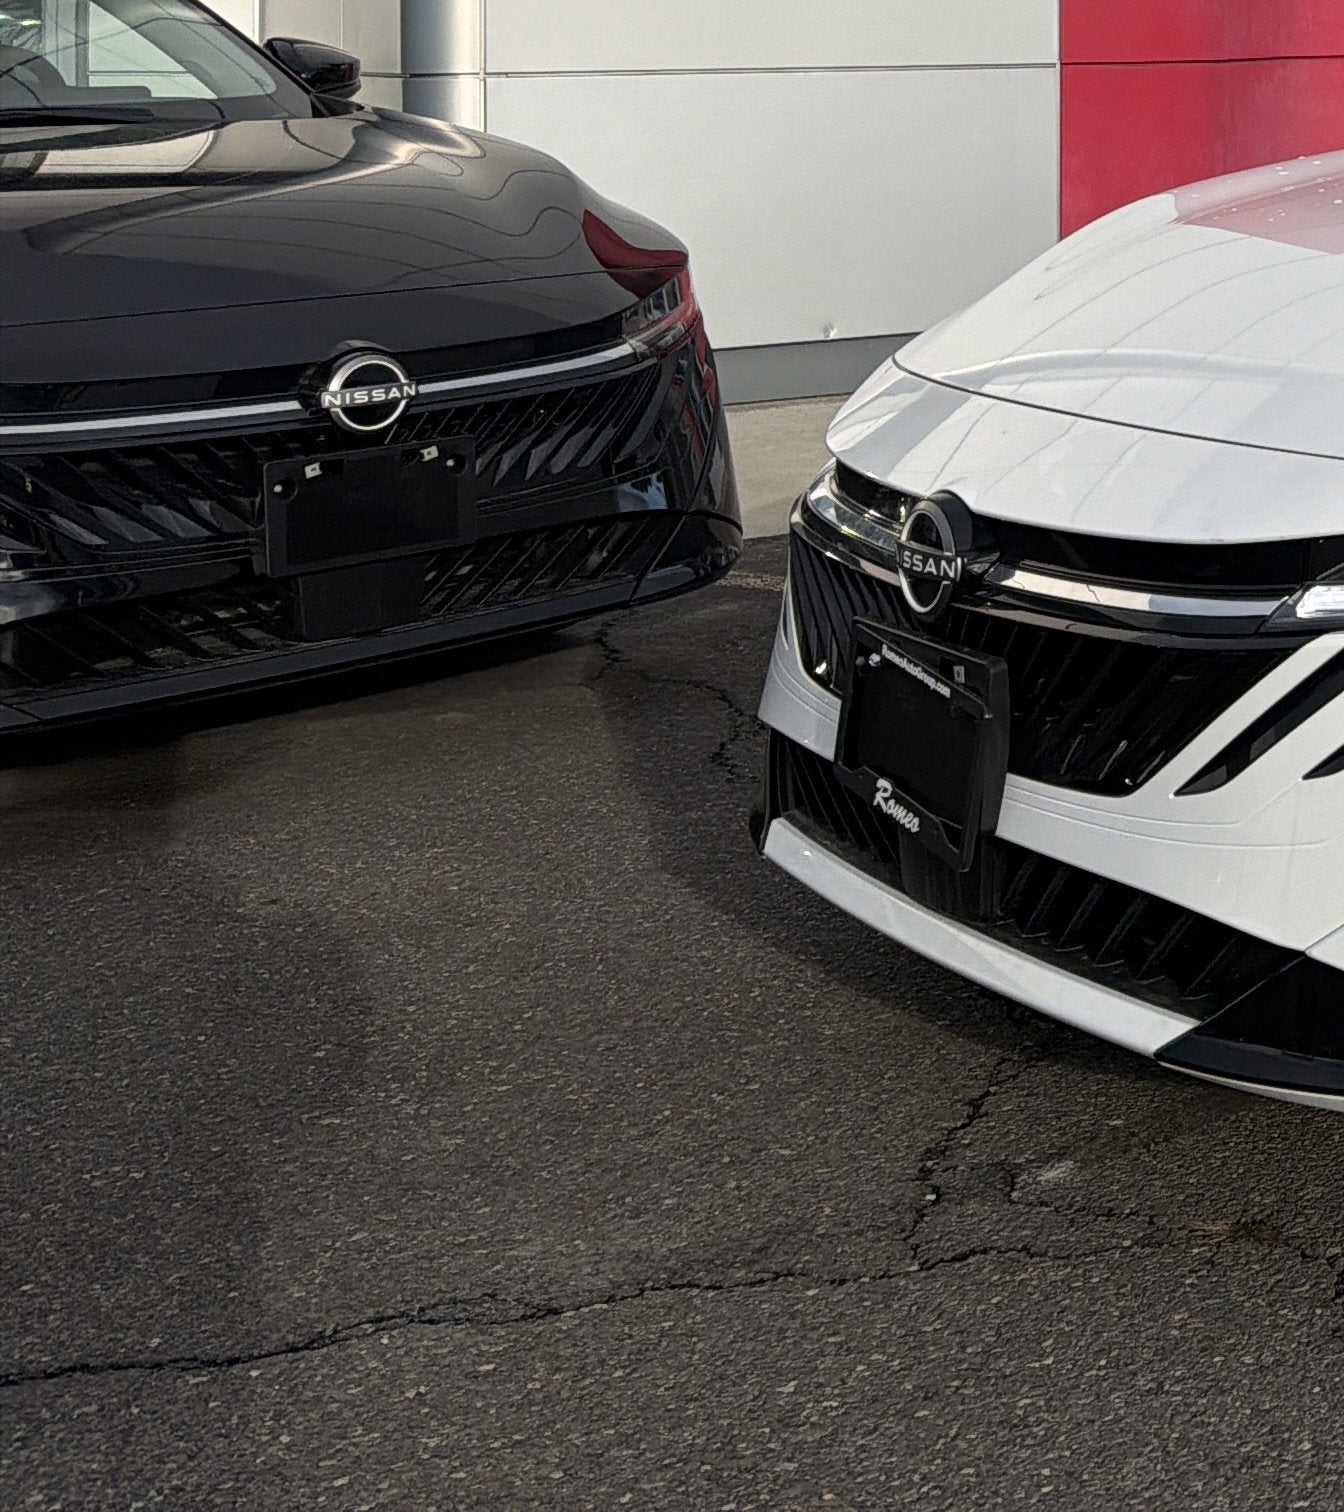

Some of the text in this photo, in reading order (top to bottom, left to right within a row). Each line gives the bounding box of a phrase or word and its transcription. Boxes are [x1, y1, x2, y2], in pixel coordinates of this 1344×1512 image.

[324, 383, 416, 407] NISSAN
[900, 549, 956, 579] SSAN
[872, 777, 921, 833] Romeo
